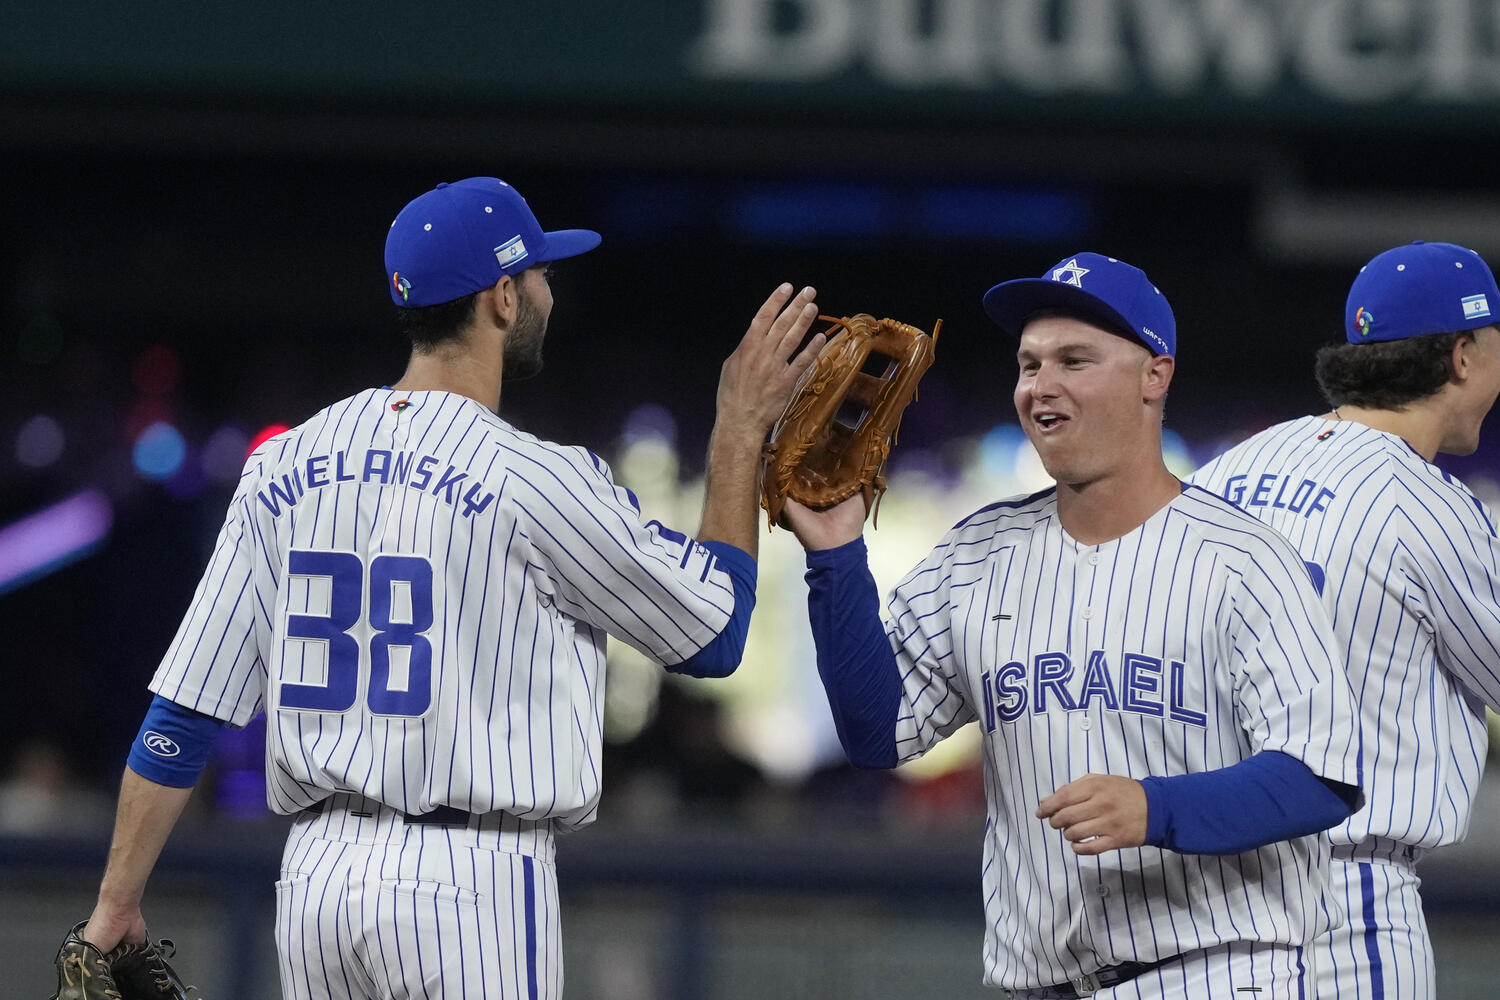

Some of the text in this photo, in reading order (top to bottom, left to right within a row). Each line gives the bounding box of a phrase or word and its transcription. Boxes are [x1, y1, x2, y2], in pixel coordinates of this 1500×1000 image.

[257, 449, 496, 519] WIELANSKY
[1223, 473, 1337, 519] GELOF
[278, 549, 434, 717] 38
[980, 648, 1209, 734] ISRAEL
